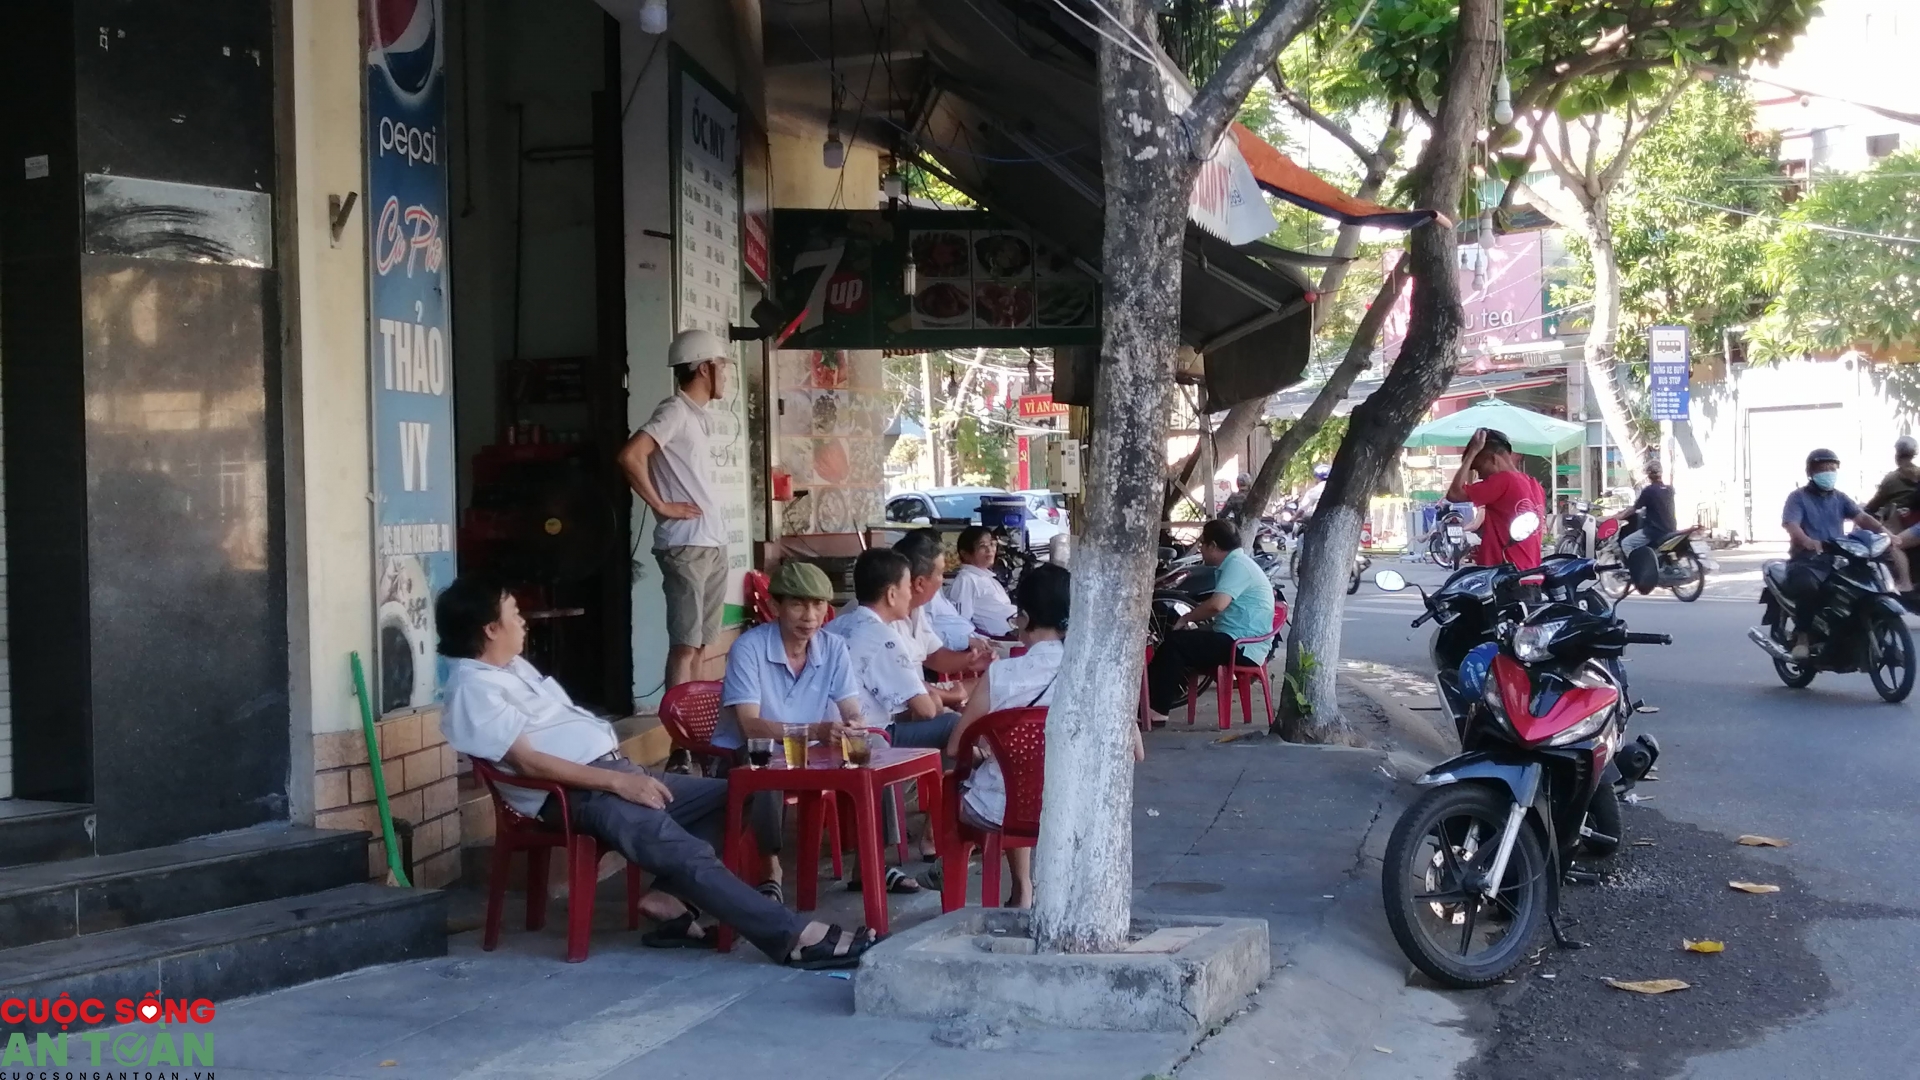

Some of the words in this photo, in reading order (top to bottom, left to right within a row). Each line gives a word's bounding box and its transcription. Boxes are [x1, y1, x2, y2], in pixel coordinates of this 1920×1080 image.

[380, 116, 437, 166] pepsi
[1481, 308, 1513, 328] tea
[380, 300, 444, 396] THẢO
[1025, 399, 1035, 413] VÌ
[1037, 400, 1051, 413] AN
[399, 421, 430, 491] VY
